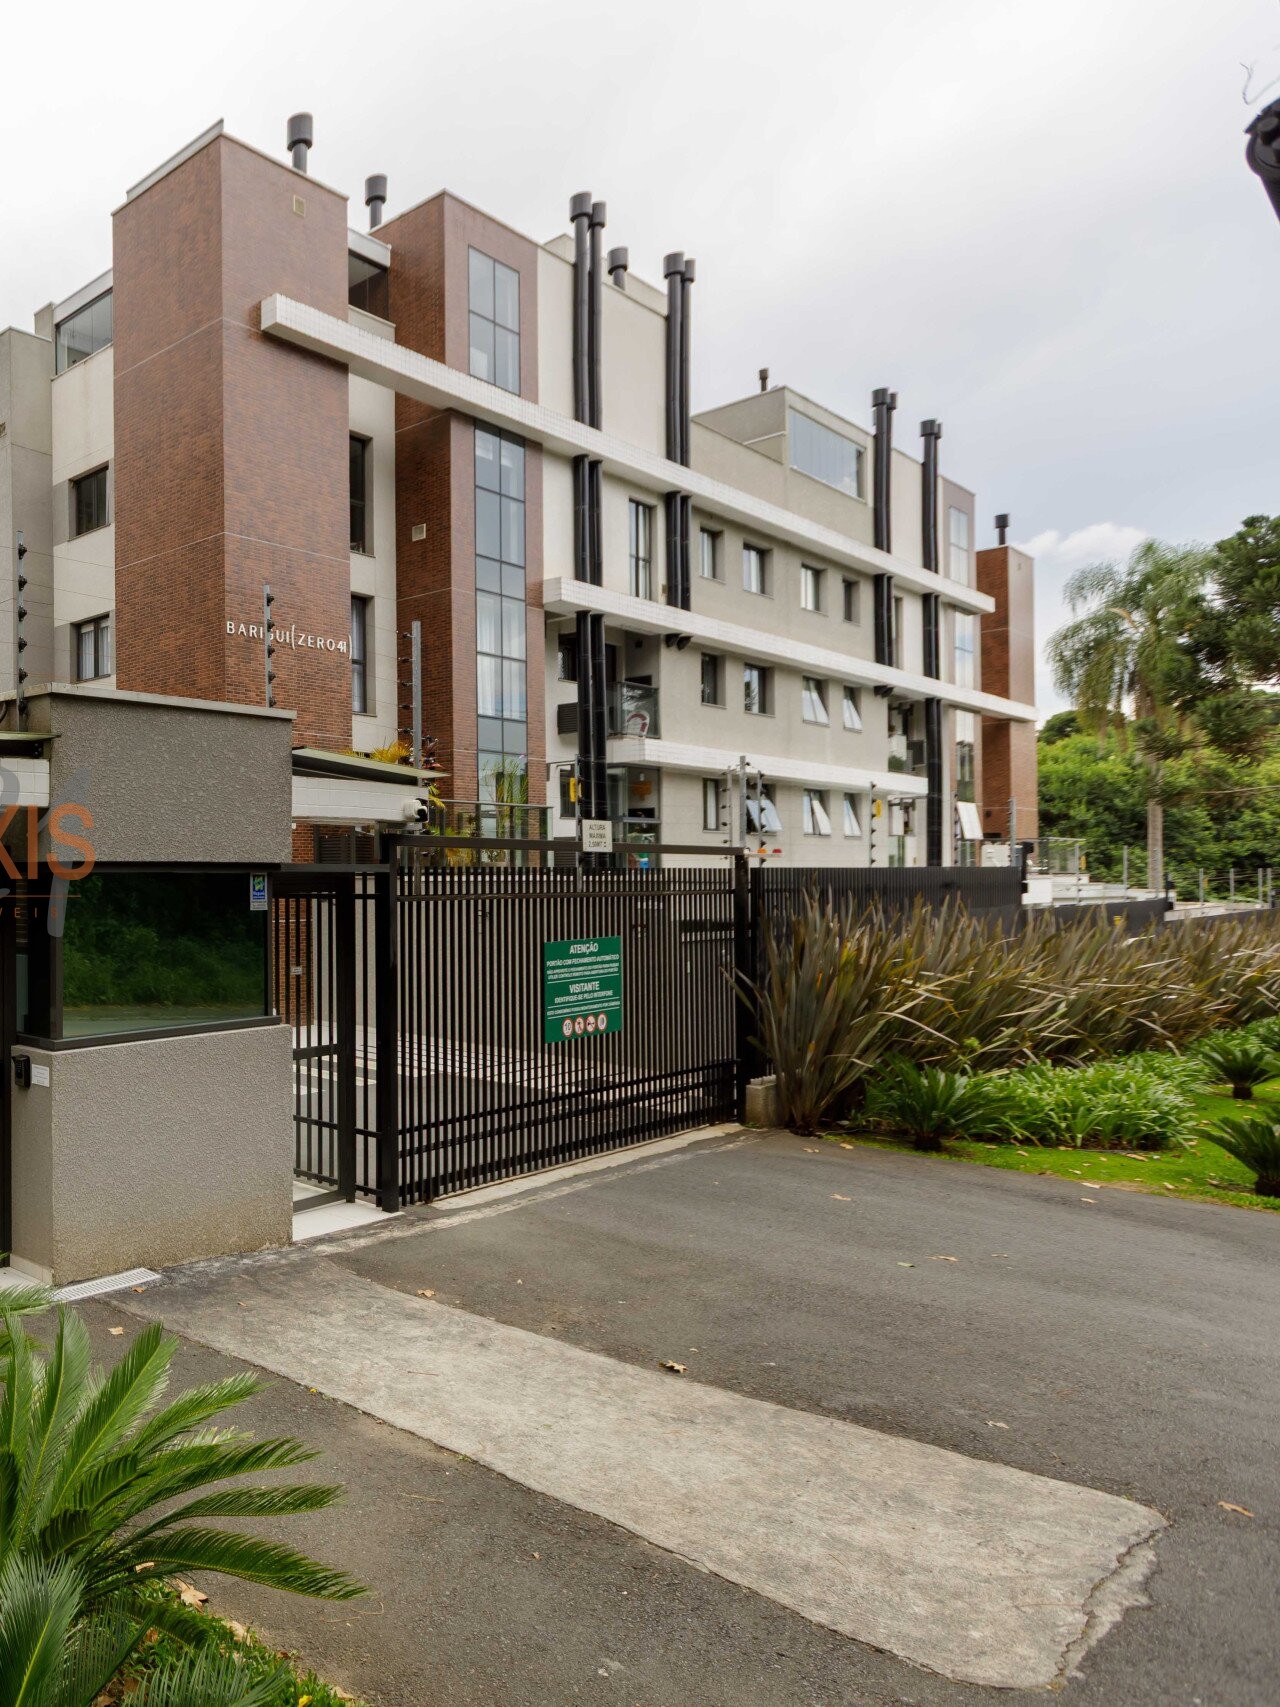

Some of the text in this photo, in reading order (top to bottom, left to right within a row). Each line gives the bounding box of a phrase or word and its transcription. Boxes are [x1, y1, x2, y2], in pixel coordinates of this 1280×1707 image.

[569, 941, 599, 955] ATENÇÃO
[563, 958, 572, 966] COM
[569, 981, 600, 993] VISITANTE
[554, 994, 584, 1004] IDENTIFIQUE-SE
